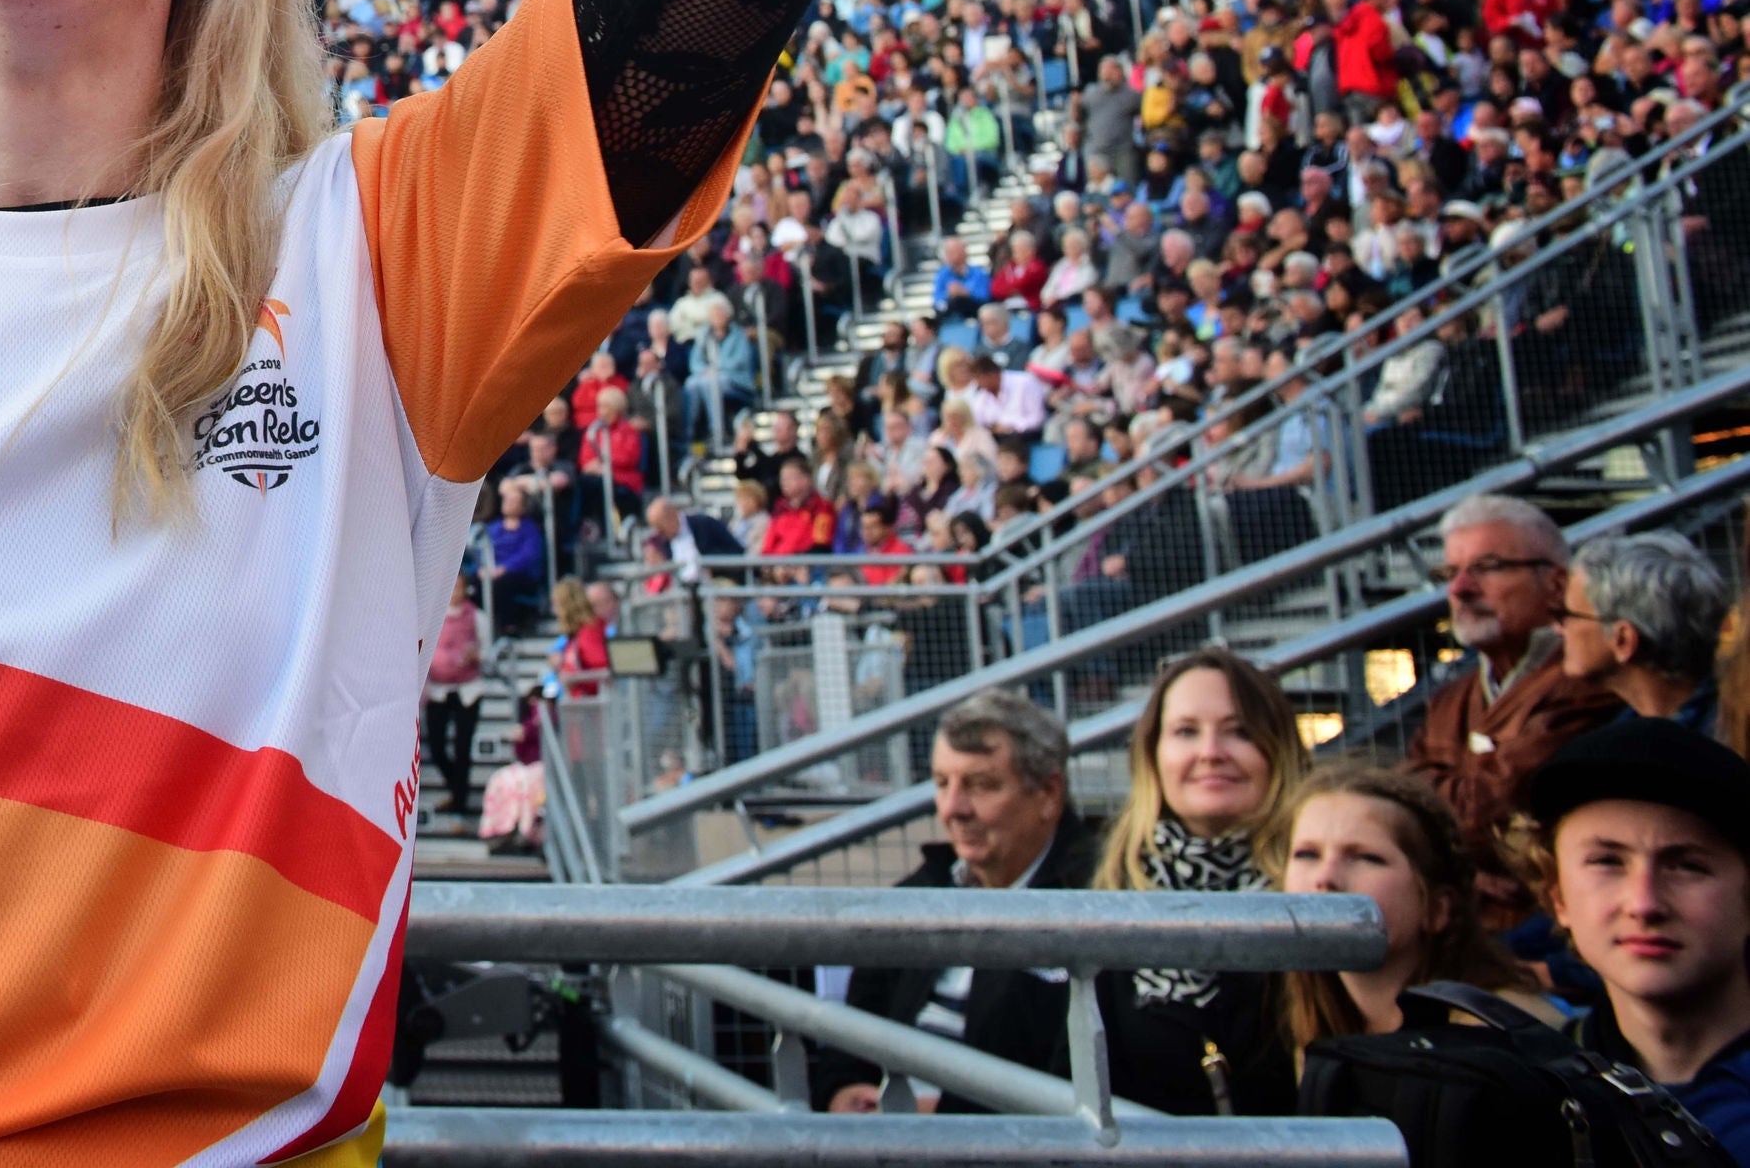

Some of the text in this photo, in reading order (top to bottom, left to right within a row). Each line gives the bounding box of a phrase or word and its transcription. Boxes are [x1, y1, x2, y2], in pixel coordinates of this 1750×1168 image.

[259, 359, 281, 370] 2018
[263, 409, 320, 445] Rela
[207, 448, 283, 465] Commonwealth
